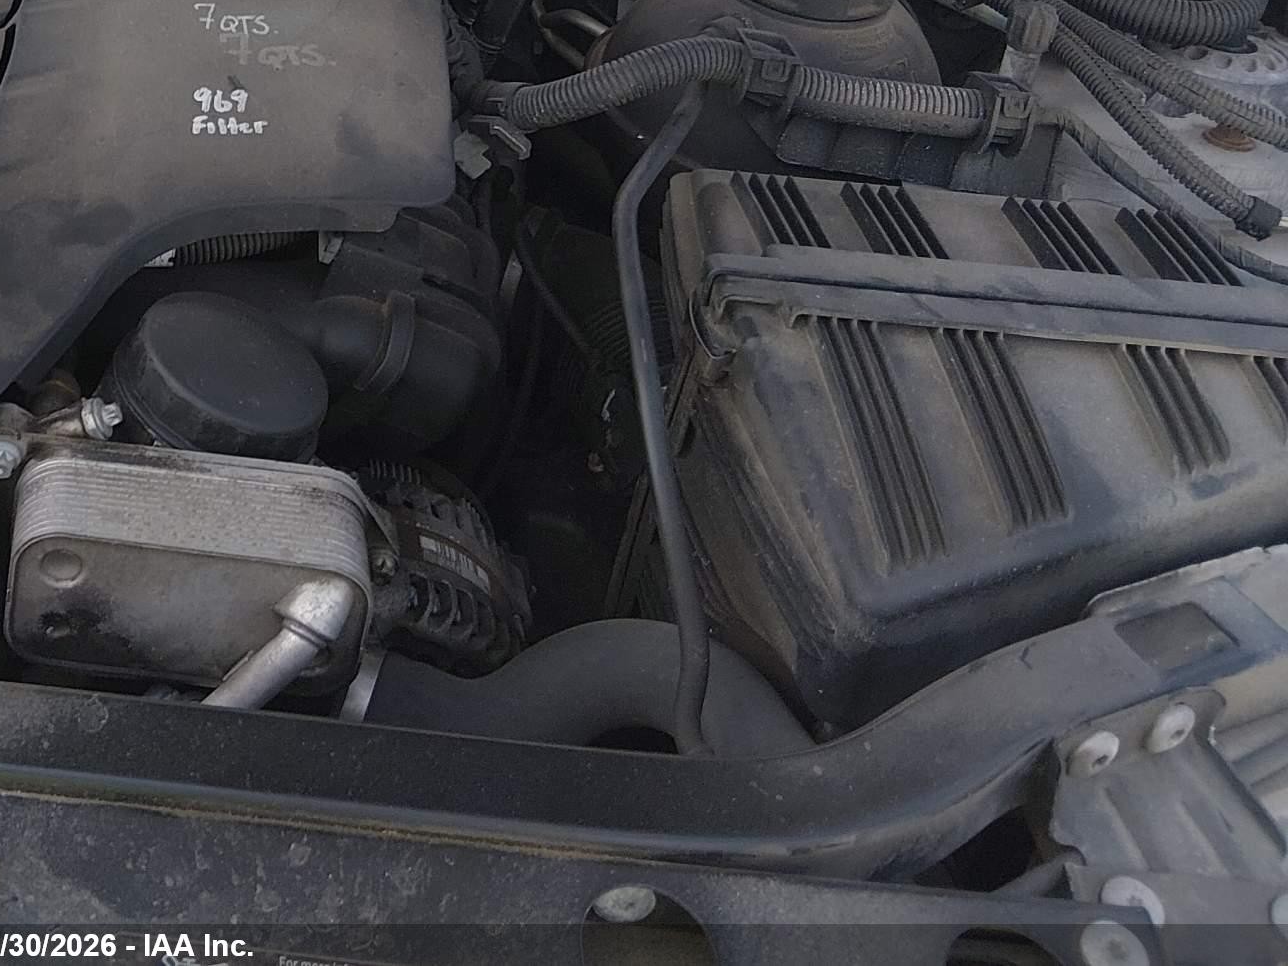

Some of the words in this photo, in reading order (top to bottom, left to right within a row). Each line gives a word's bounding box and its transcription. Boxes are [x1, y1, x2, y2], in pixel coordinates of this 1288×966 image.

[193, 2, 216, 30] 7
[193, 87, 249, 113] 969
[192, 116, 268, 134] Filter
